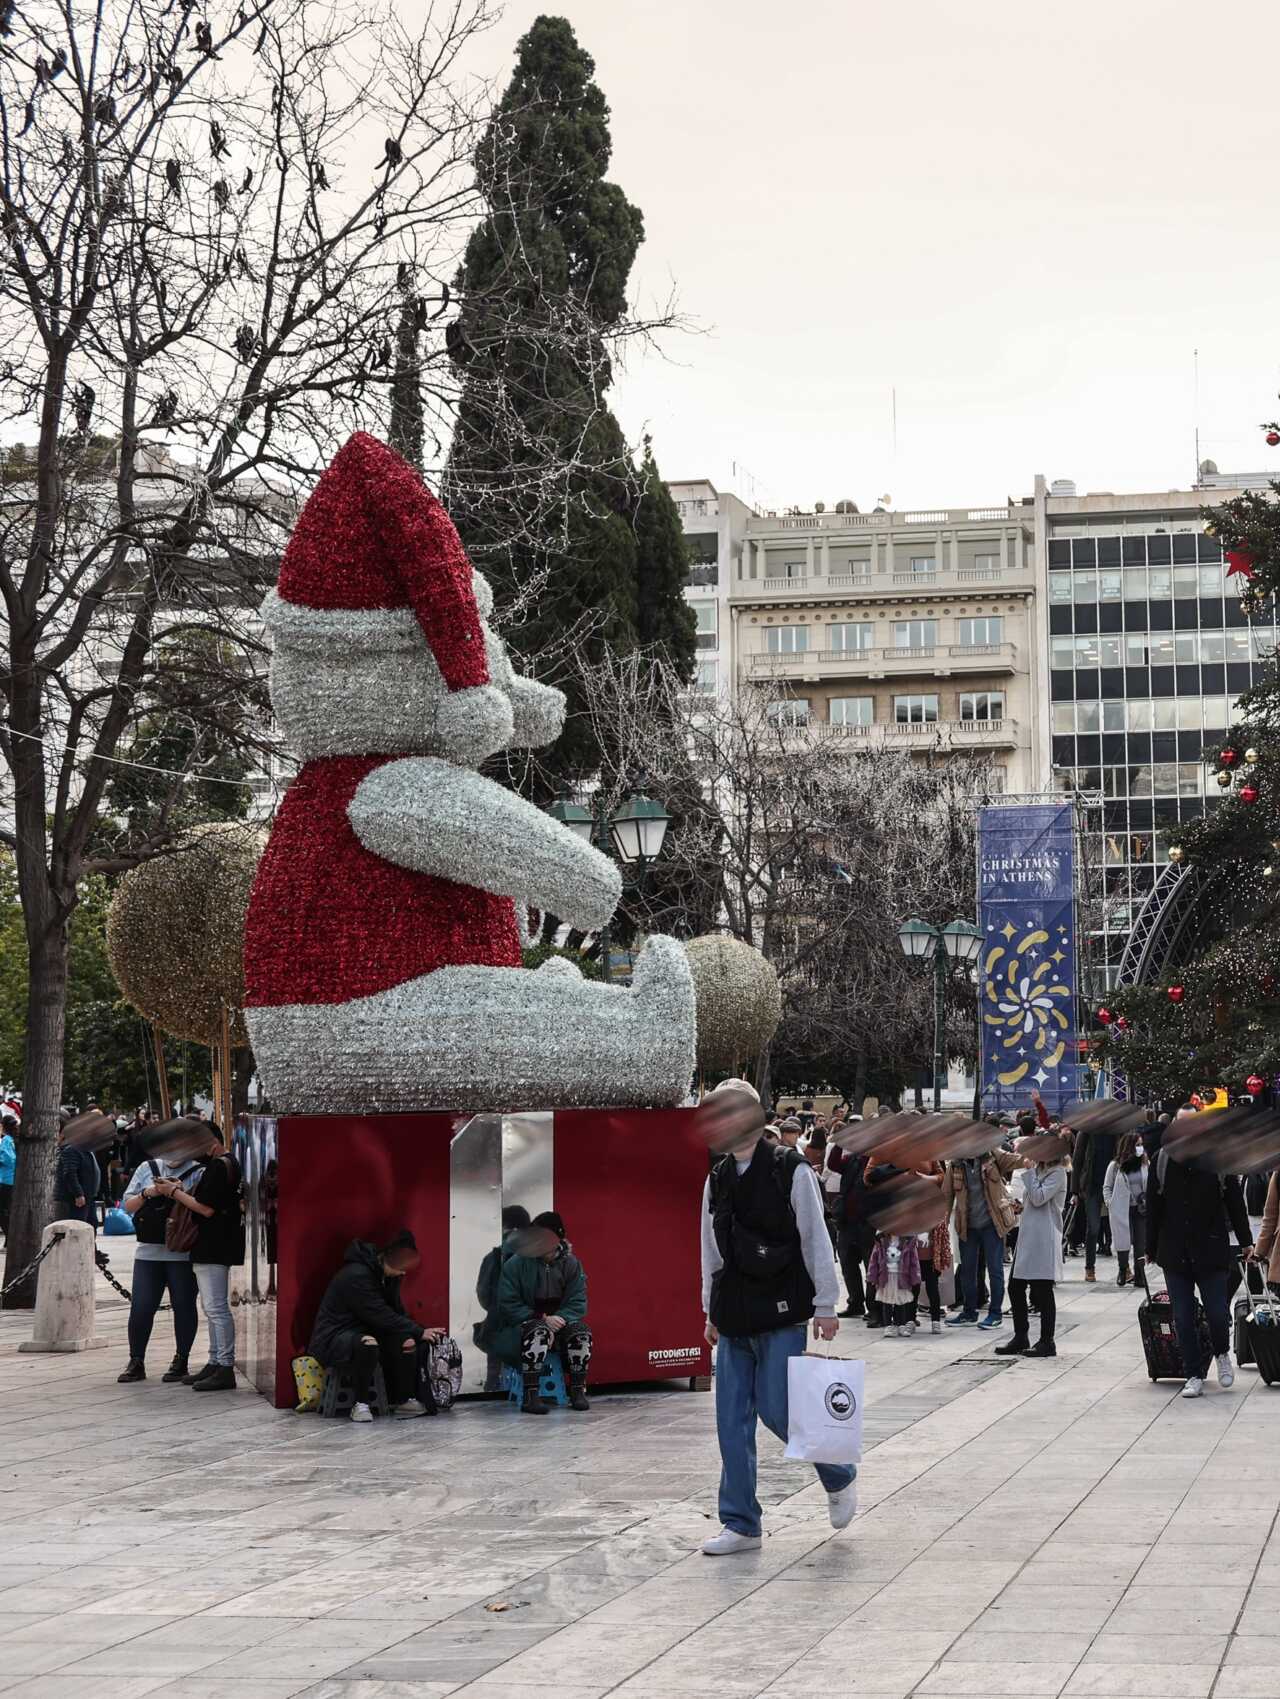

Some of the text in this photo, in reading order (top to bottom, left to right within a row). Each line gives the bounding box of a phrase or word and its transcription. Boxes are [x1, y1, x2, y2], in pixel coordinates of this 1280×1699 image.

[982, 858, 1060, 870] CHRISTMAS
[982, 870, 1052, 884] IN ATHENS
[648, 1347, 701, 1360] FOTODIASTASI
